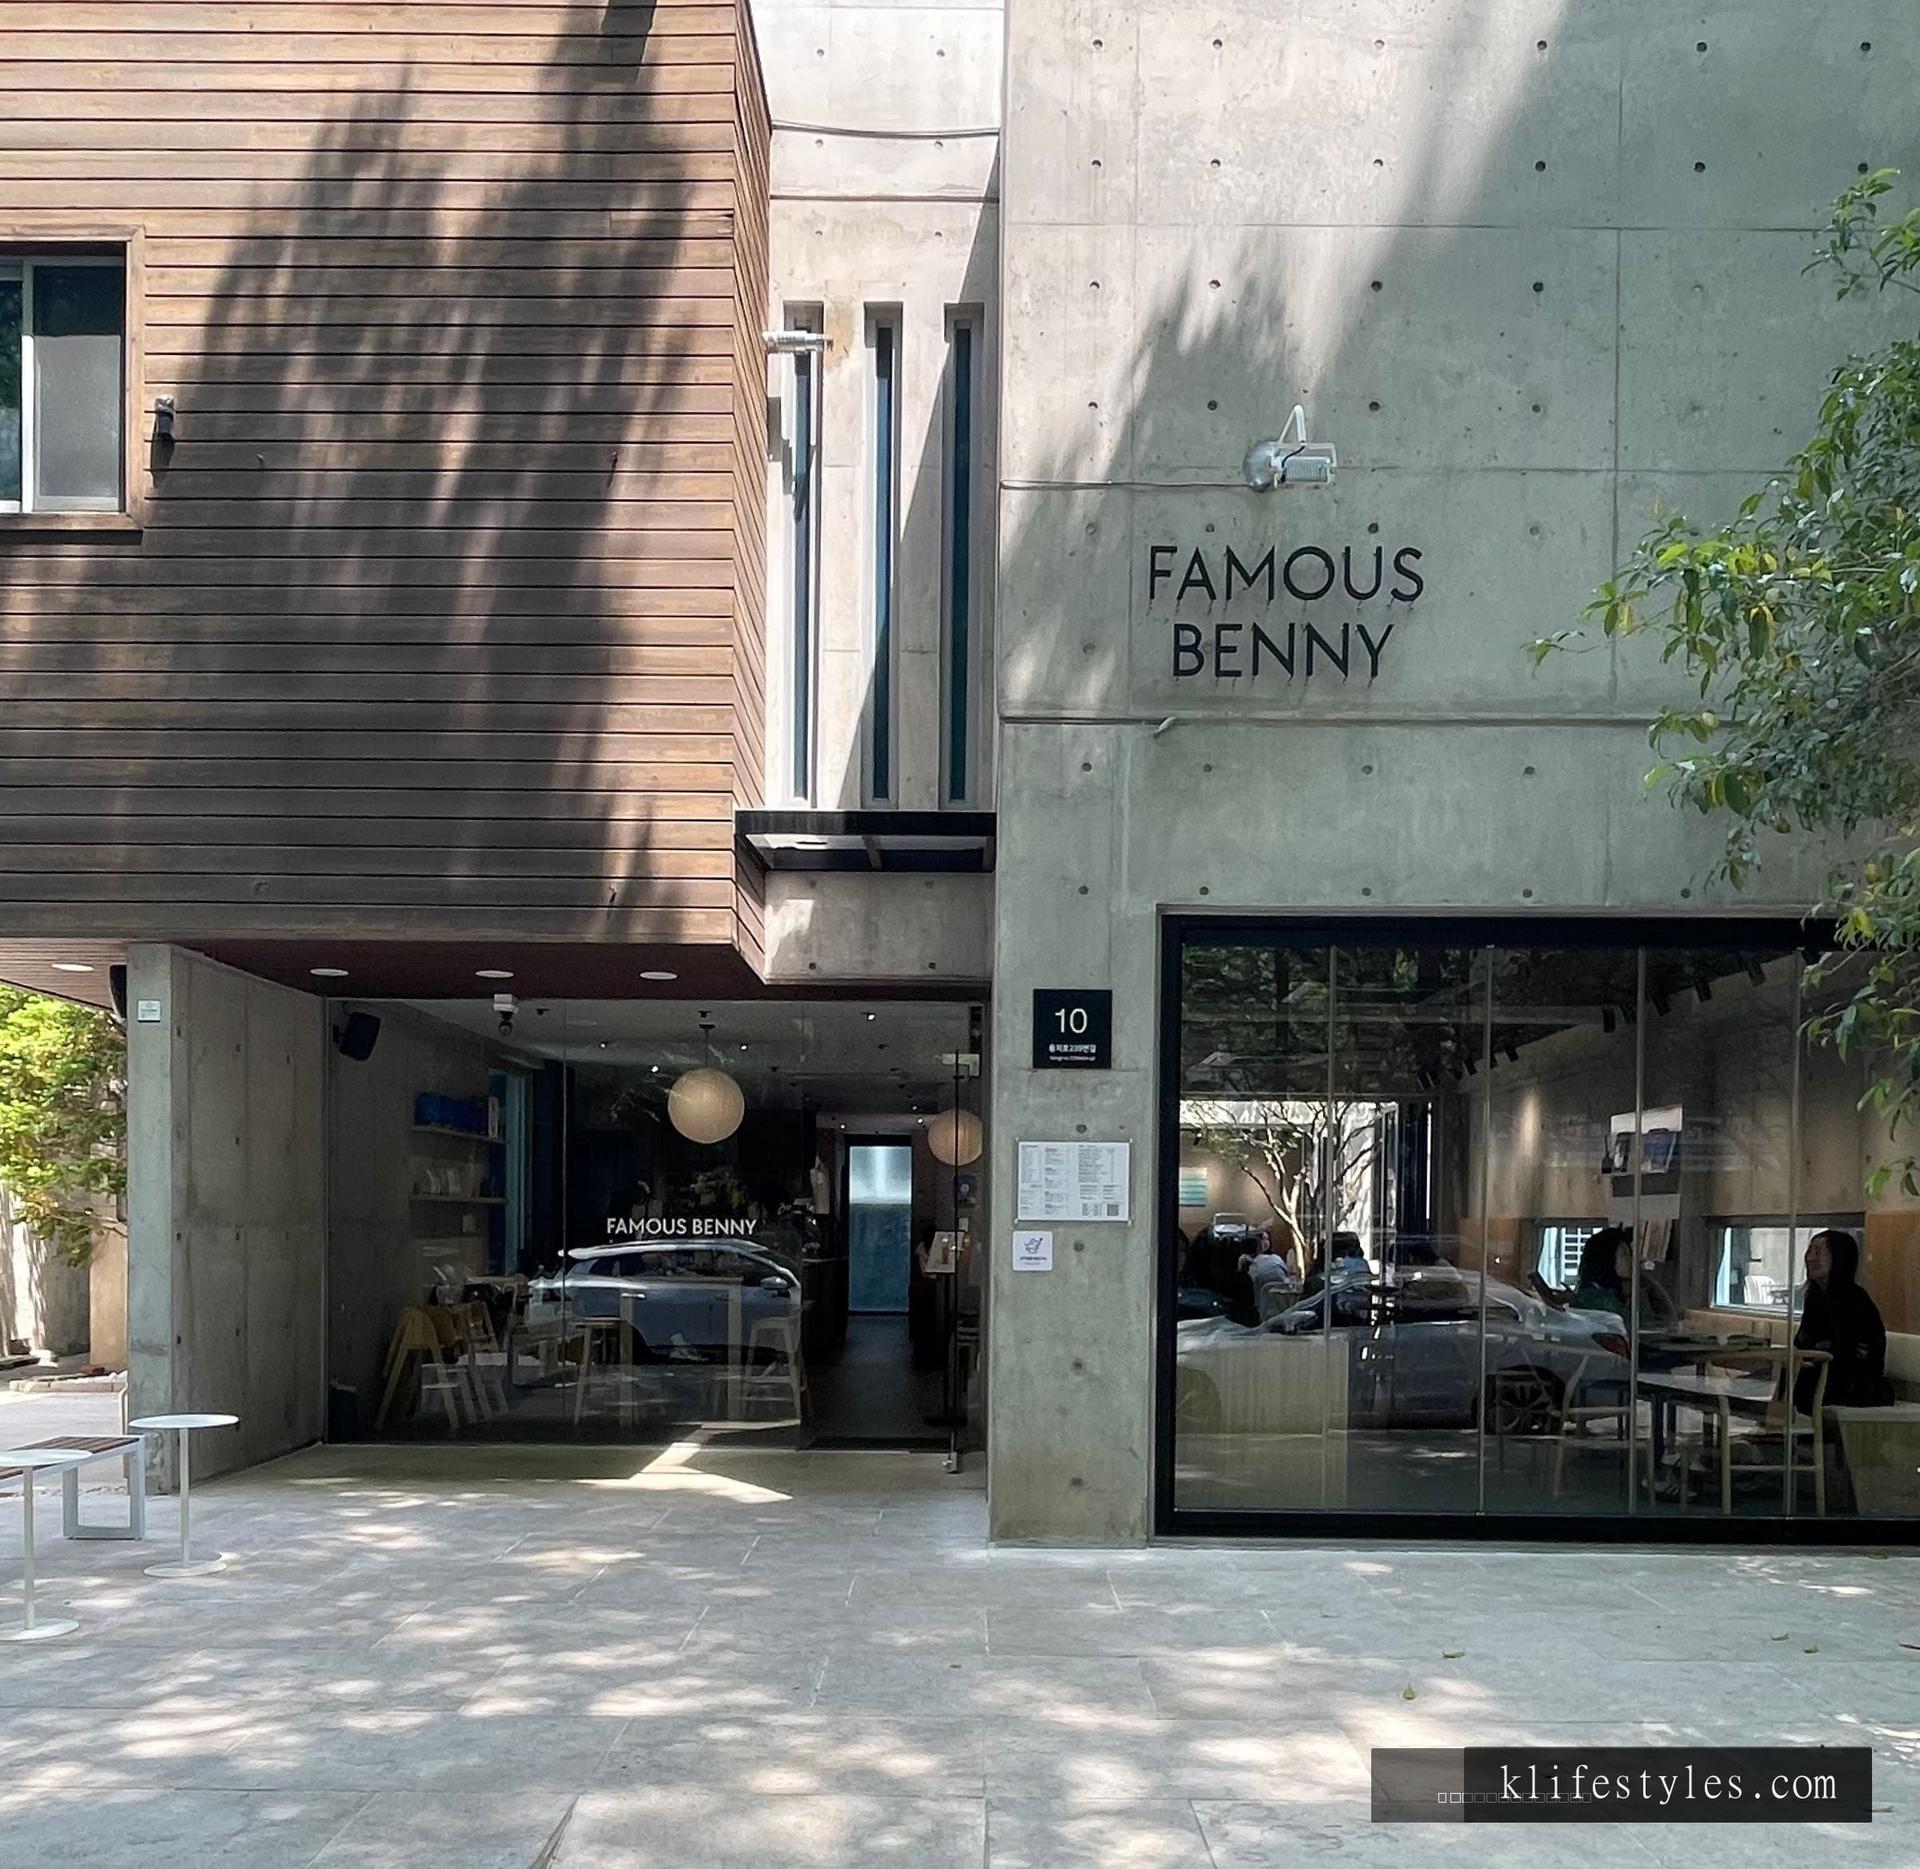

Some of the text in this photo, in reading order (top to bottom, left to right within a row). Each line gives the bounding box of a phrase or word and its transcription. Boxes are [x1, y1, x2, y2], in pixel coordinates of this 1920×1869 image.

[1149, 545, 1425, 602] FAMOUS
[1172, 622, 1395, 678] BENNY
[1054, 1007, 1088, 1034] 10
[606, 1217, 757, 1236] FAMOUS BENNY
